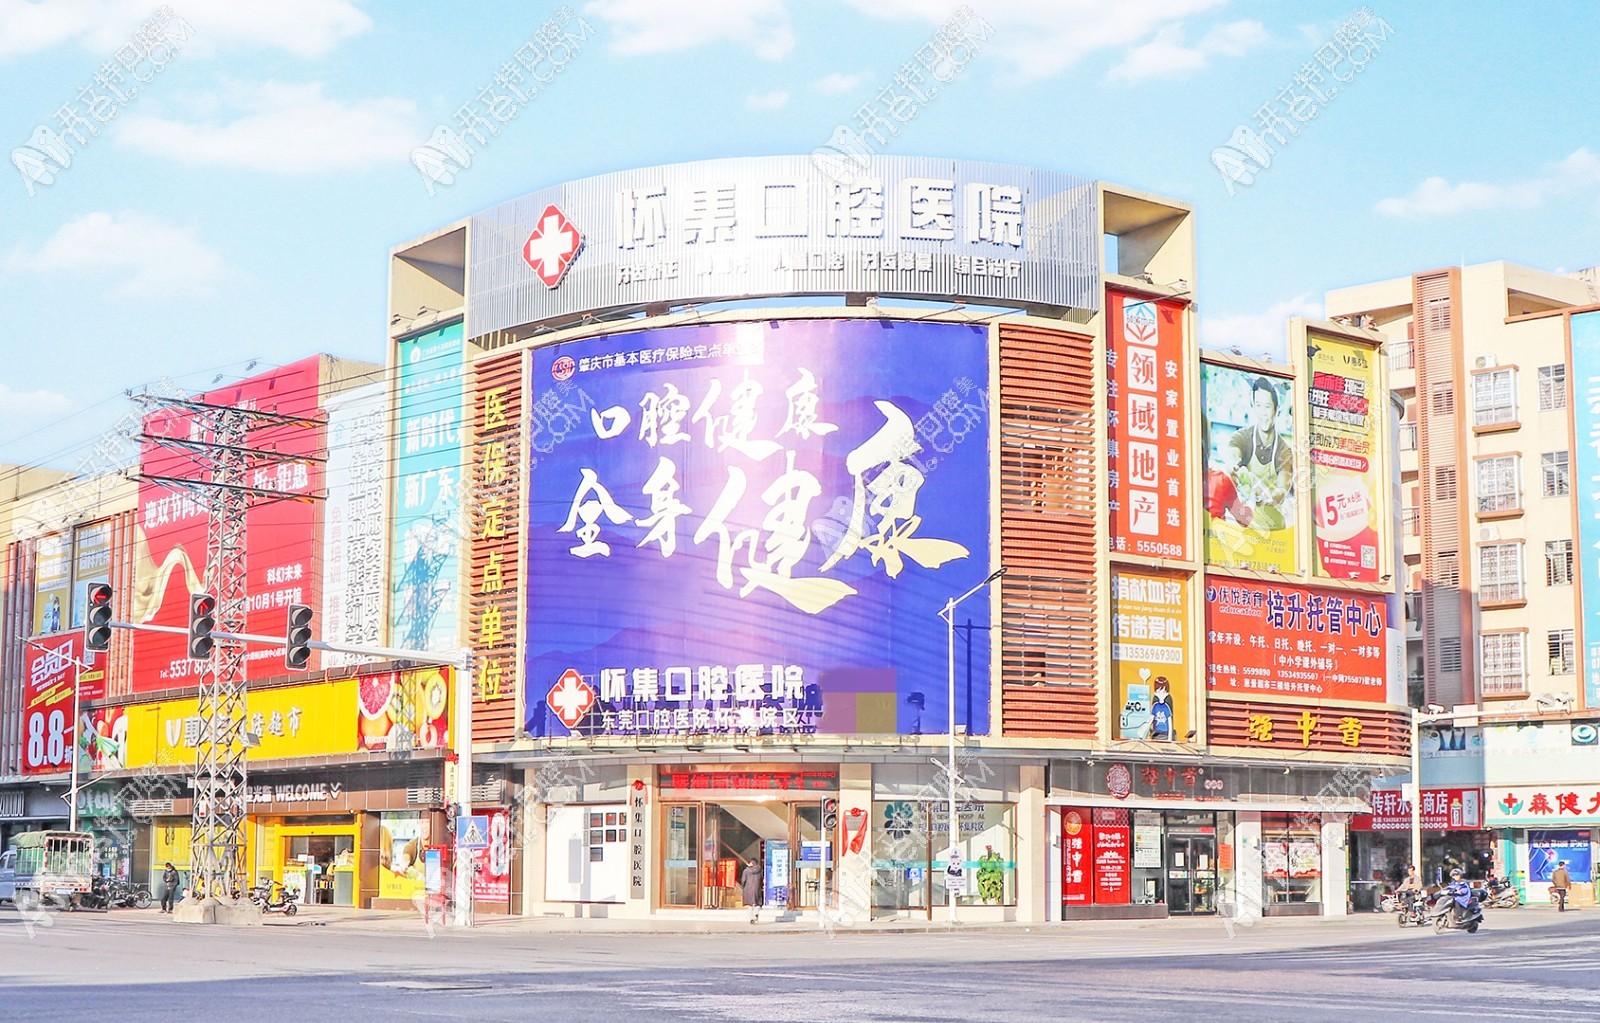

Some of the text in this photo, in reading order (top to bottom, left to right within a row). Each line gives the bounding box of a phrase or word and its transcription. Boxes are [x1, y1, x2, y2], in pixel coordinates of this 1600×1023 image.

[615, 177, 1024, 250] 怀集口腔医院
[578, 342, 750, 374] 肇庆市基本医疗保险定点单
[590, 367, 840, 461] 口腔健康
[1130, 352, 1156, 527] 领域地产
[1165, 359, 1180, 528] 安家置业首选
[556, 400, 970, 615] 全身健康
[480, 385, 507, 703] 医保定点单位
[1137, 540, 1183, 556] 5550588
[267, 563, 302, 586] 科幻未来
[1112, 576, 1182, 606] 捐献血浆
[1219, 585, 1263, 607] 优悦教育
[1112, 612, 1183, 642] 传递爱心
[1219, 605, 1263, 618] education
[1267, 589, 1383, 638] 培升托管中心
[1124, 646, 1181, 662] 13536969300
[600, 663, 805, 703] 怀集口腔医院
[600, 707, 801, 731] 东莞口腔医院怀集院区
[275, 782, 328, 802] WELCOME
[632, 796, 645, 887] 怀集口腔医院
